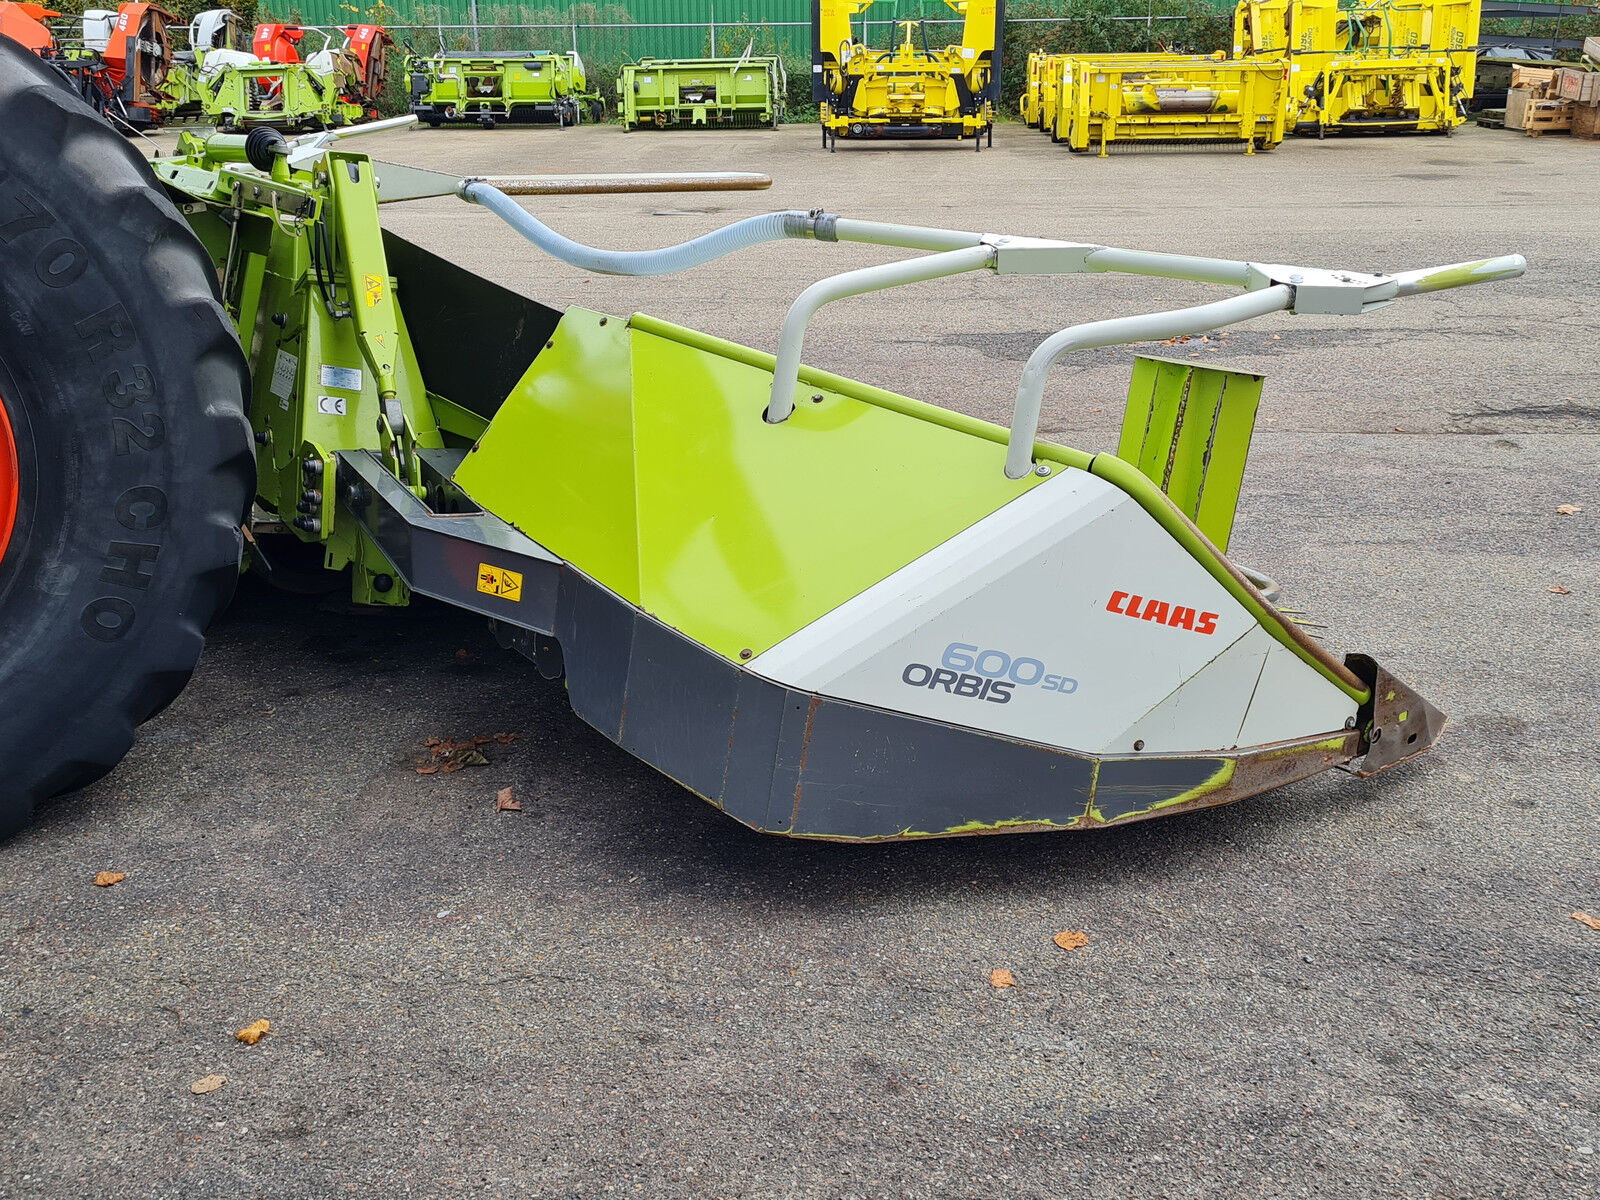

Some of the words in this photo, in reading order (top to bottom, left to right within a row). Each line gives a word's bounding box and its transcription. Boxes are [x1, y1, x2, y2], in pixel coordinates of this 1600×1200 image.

[118, 13, 129, 32] 460
[80, 485, 168, 643] CHO
[1105, 590, 1219, 635] CLAAS
[902, 663, 1016, 705] ORBIS
